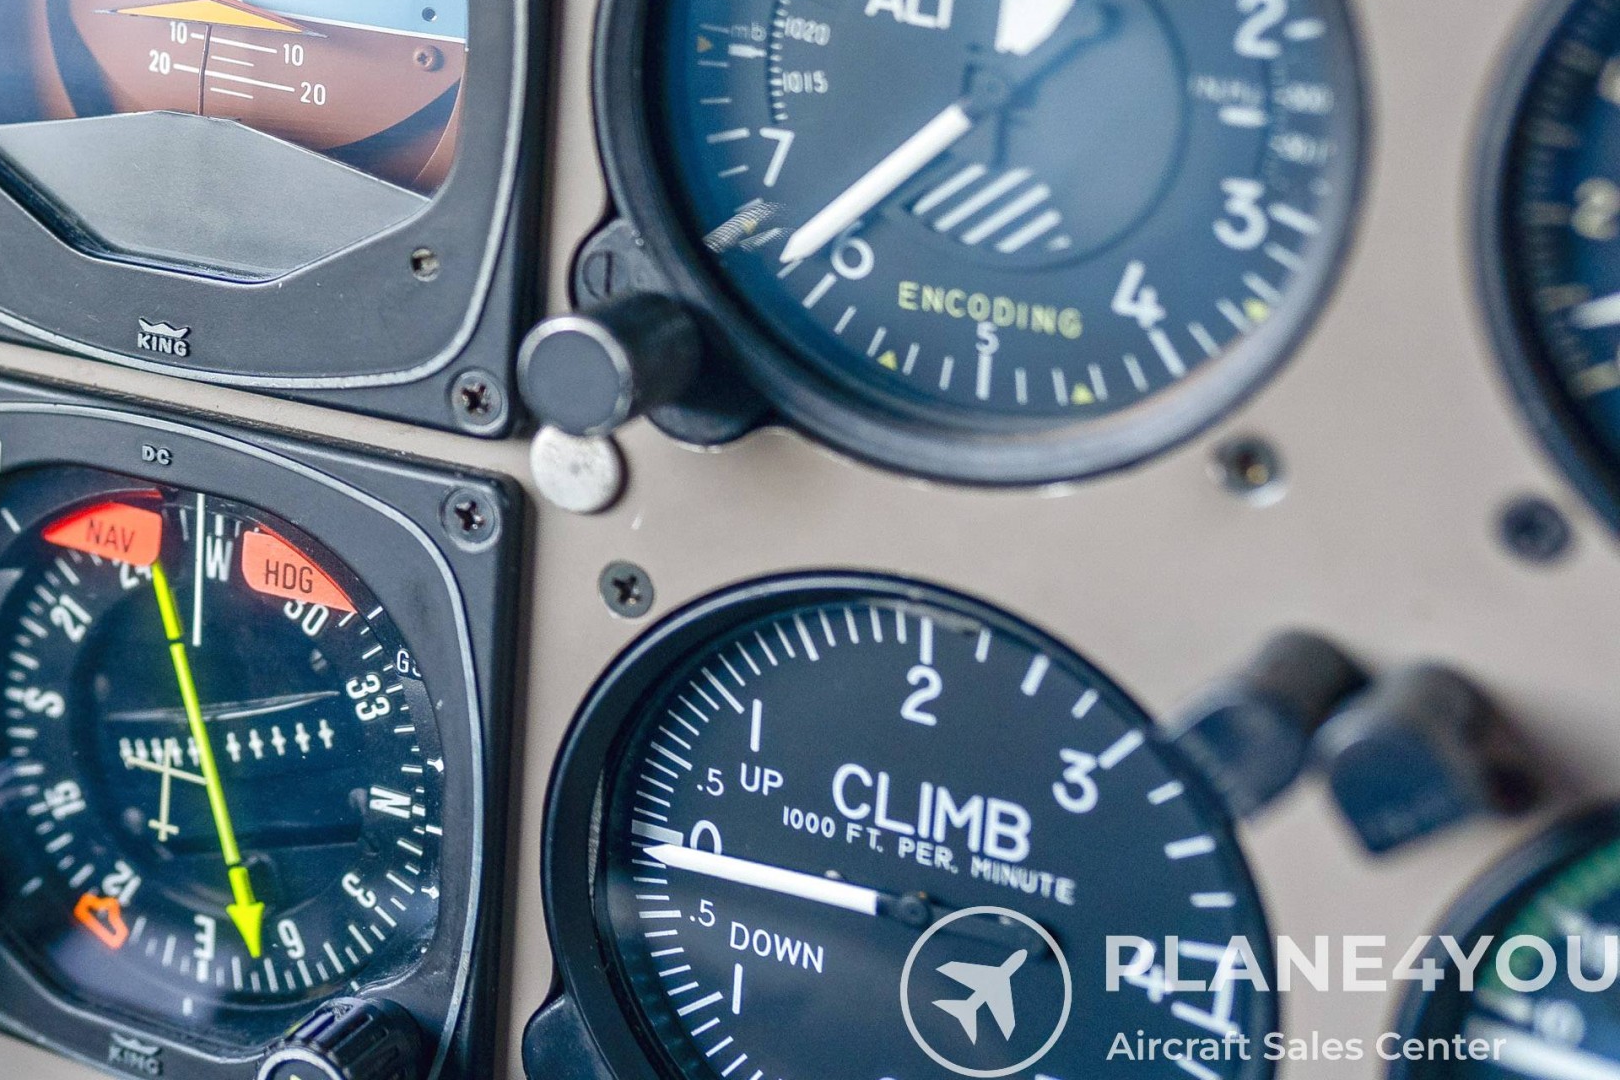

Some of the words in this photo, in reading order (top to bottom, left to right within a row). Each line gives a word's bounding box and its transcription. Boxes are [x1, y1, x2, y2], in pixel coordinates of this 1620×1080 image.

[169, 21, 188, 44] 10
[148, 50, 171, 75] 20
[283, 44, 304, 66] 10
[300, 81, 327, 106] 20
[783, 70, 828, 94] 1015
[759, 127, 795, 187] 7
[1213, 178, 1268, 250] 3
[898, 280, 1083, 340] ENCODING
[1111, 261, 1165, 322] 4
[137, 333, 188, 357] KING
[141, 444, 172, 466] DC
[86, 519, 135, 553] NAV
[205, 534, 233, 582] W
[264, 560, 313, 594] HDG
[50, 595, 92, 642] 21
[22, 687, 66, 718] S
[346, 673, 391, 721] 33
[900, 665, 944, 726] 2
[750, 698, 763, 752] 1
[696, 768, 725, 797] .5
[739, 762, 784, 795] UP
[1051, 748, 1098, 814] 3
[42, 780, 86, 820] 15
[369, 785, 413, 819] N
[832, 763, 1032, 864] CLIMB
[782, 807, 836, 839] 1000
[845, 821, 884, 853] FT.
[897, 837, 959, 875] PER.
[969, 855, 1077, 907] MINUTE
[100, 860, 143, 906] 12
[341, 872, 378, 909] 3
[688, 897, 717, 927] .5
[193, 915, 217, 960] E
[276, 919, 306, 960] 6
[730, 923, 824, 973] DOWN
[733, 964, 742, 1015] 1
